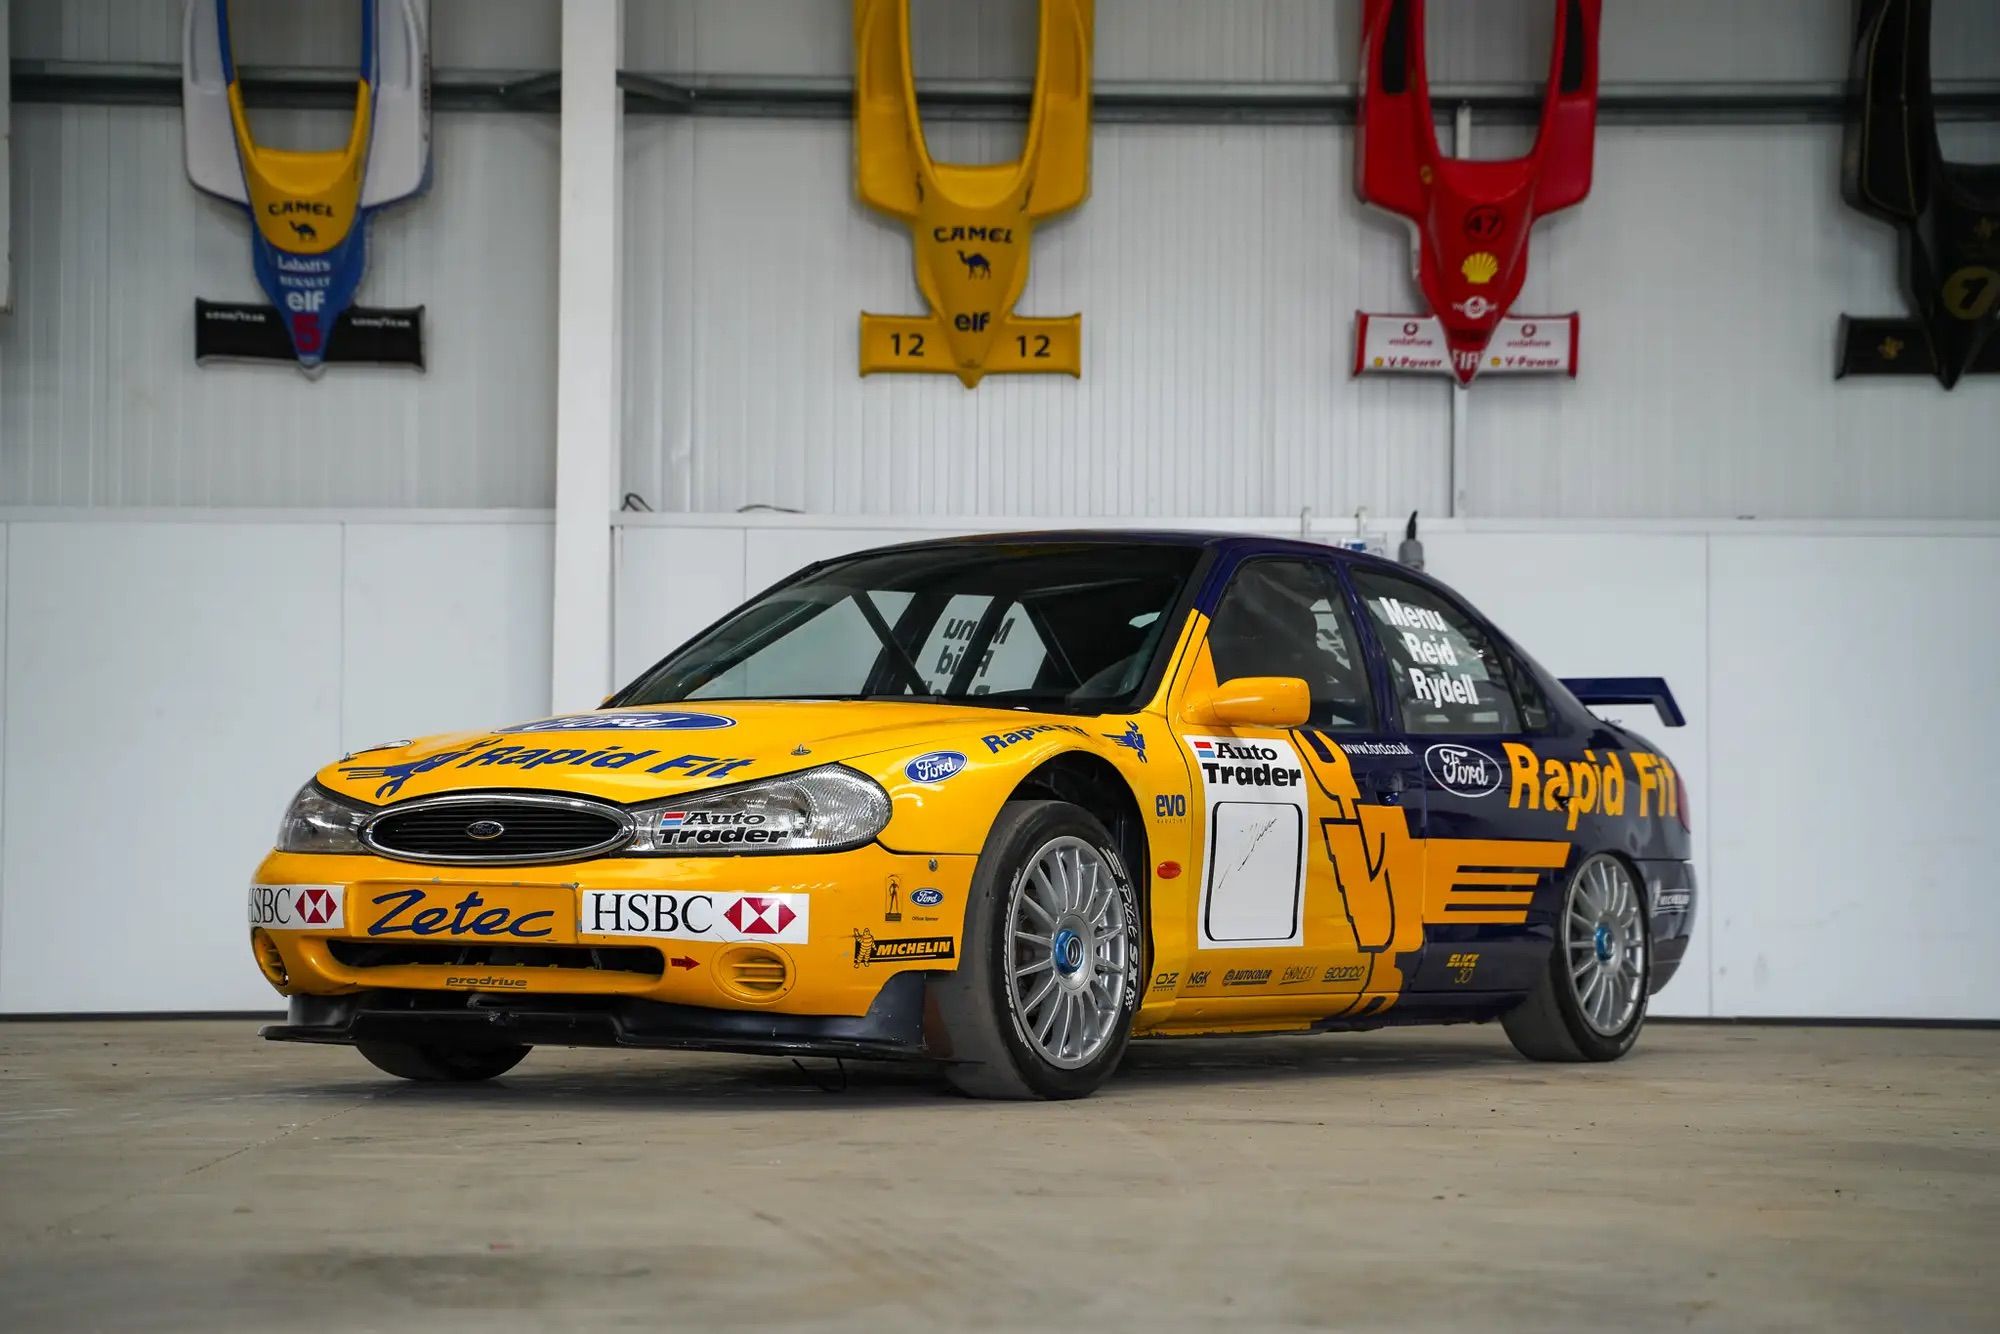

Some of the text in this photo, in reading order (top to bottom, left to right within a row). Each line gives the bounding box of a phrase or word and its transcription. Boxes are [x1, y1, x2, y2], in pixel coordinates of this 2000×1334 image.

[268, 201, 335, 218] CAMEL
[933, 226, 1014, 244] CAMEL
[286, 290, 326, 313] elf
[292, 313, 322, 353] 5
[954, 312, 990, 333] elf
[890, 332, 925, 357] 12
[1016, 334, 1051, 358] 12
[1378, 596, 1449, 633] Menu
[1403, 632, 1459, 667] Reid
[1408, 667, 1480, 709] Rydell
[980, 725, 1057, 754] Rapid
[1214, 741, 1278, 761] Auto
[456, 745, 758, 779] Rapid Fit
[916, 758, 958, 781] Ford
[1438, 748, 1489, 787] Ford
[1202, 762, 1302, 787] Trader
[1501, 742, 1678, 832] Rapid Fit
[1155, 794, 1186, 817] evo
[681, 811, 767, 827] Auto
[657, 825, 789, 845] Trader
[916, 889, 938, 903] Ford
[366, 889, 555, 937] Zetec
[591, 893, 714, 934] HSBC
[1119, 883, 1139, 938] Pilot
[875, 940, 951, 957] MICHELIN
[445, 975, 528, 989] prodrive
[1187, 970, 1212, 985] NGK
